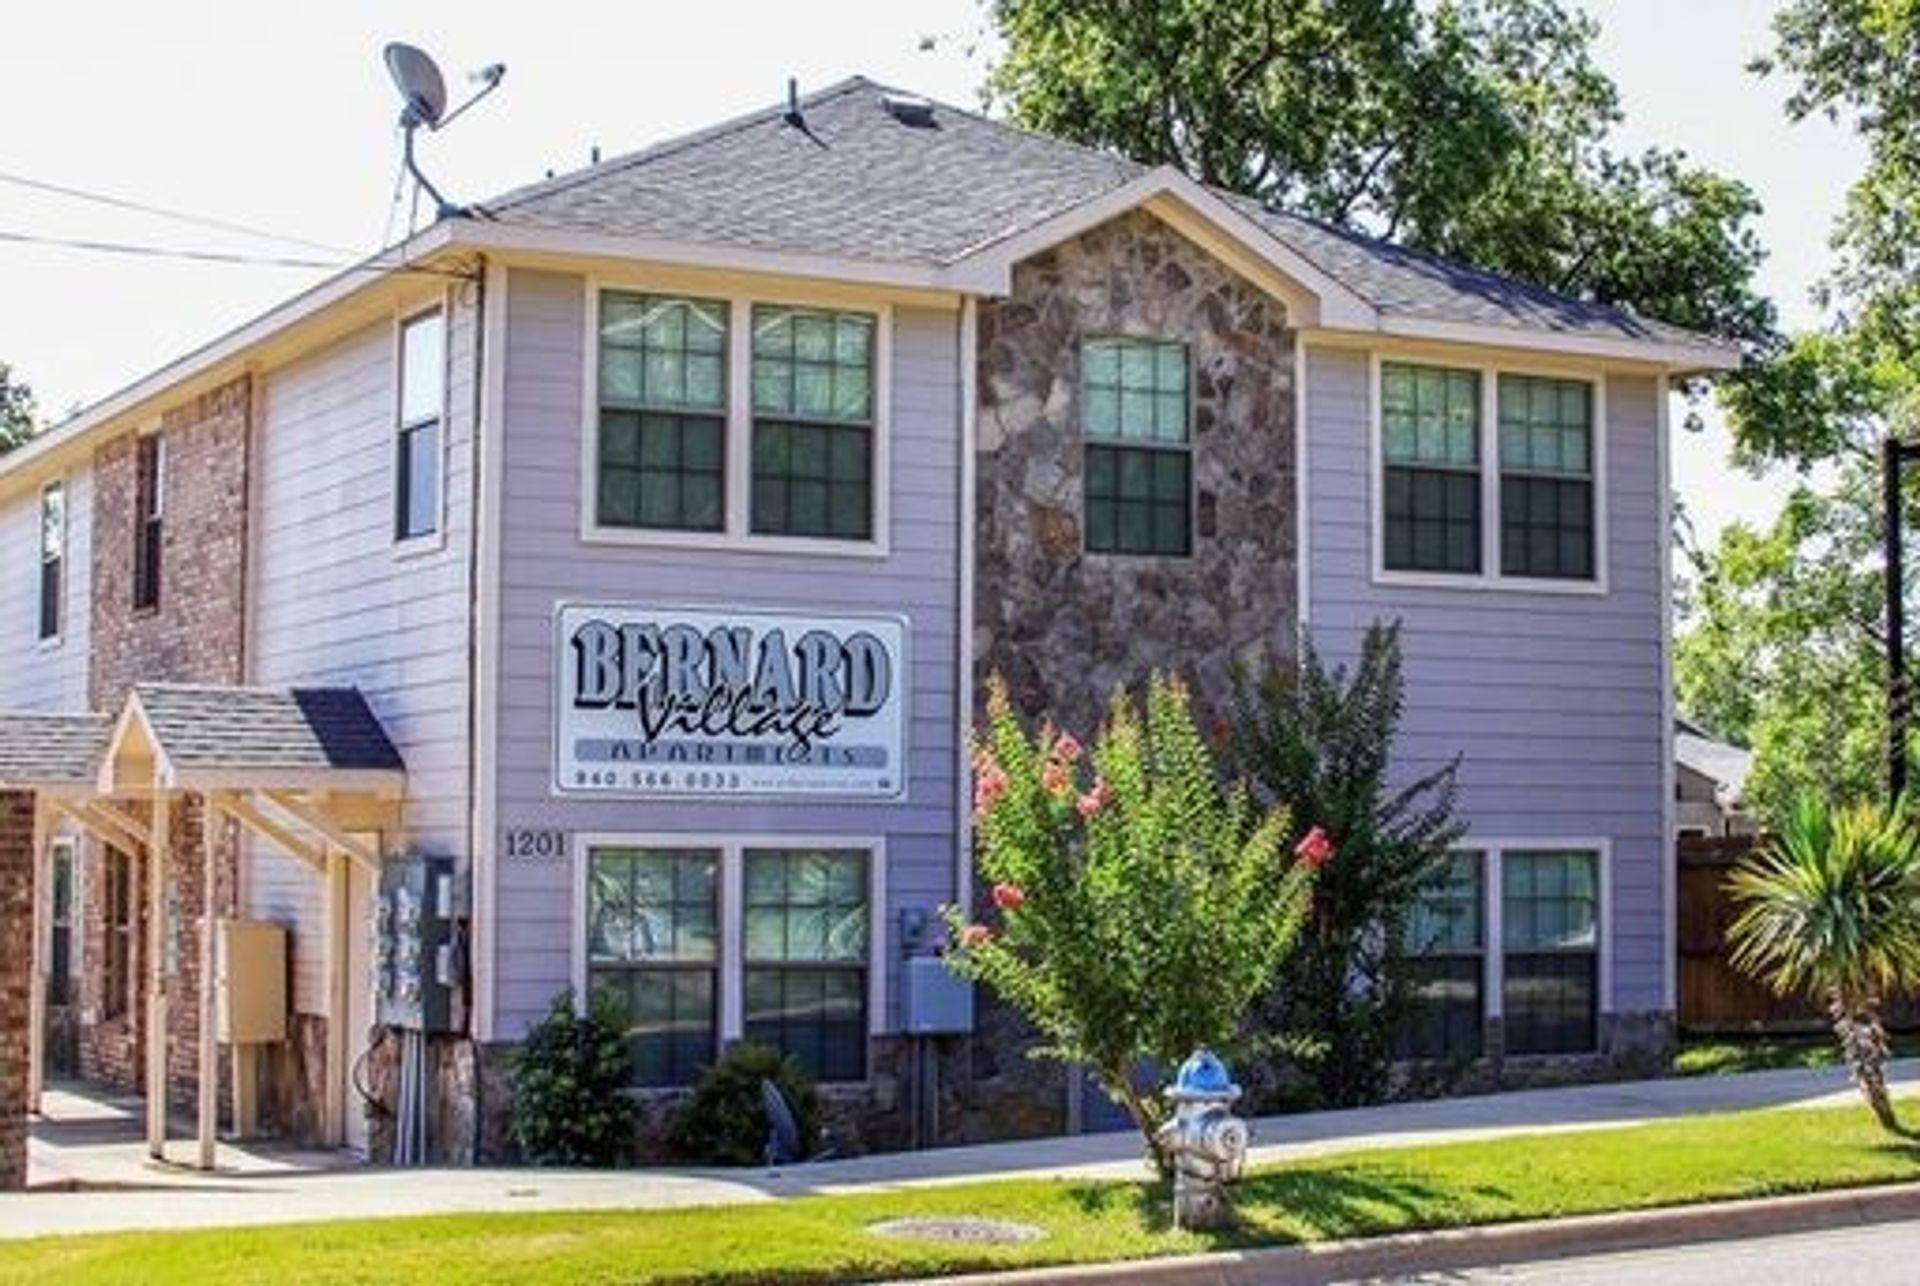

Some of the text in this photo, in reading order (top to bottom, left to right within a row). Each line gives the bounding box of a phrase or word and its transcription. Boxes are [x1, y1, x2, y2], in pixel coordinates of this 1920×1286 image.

[571, 619, 891, 717] BERNARD
[637, 683, 843, 764] Village
[610, 741, 855, 765] APARTMETS
[507, 830, 564, 856] 1201
